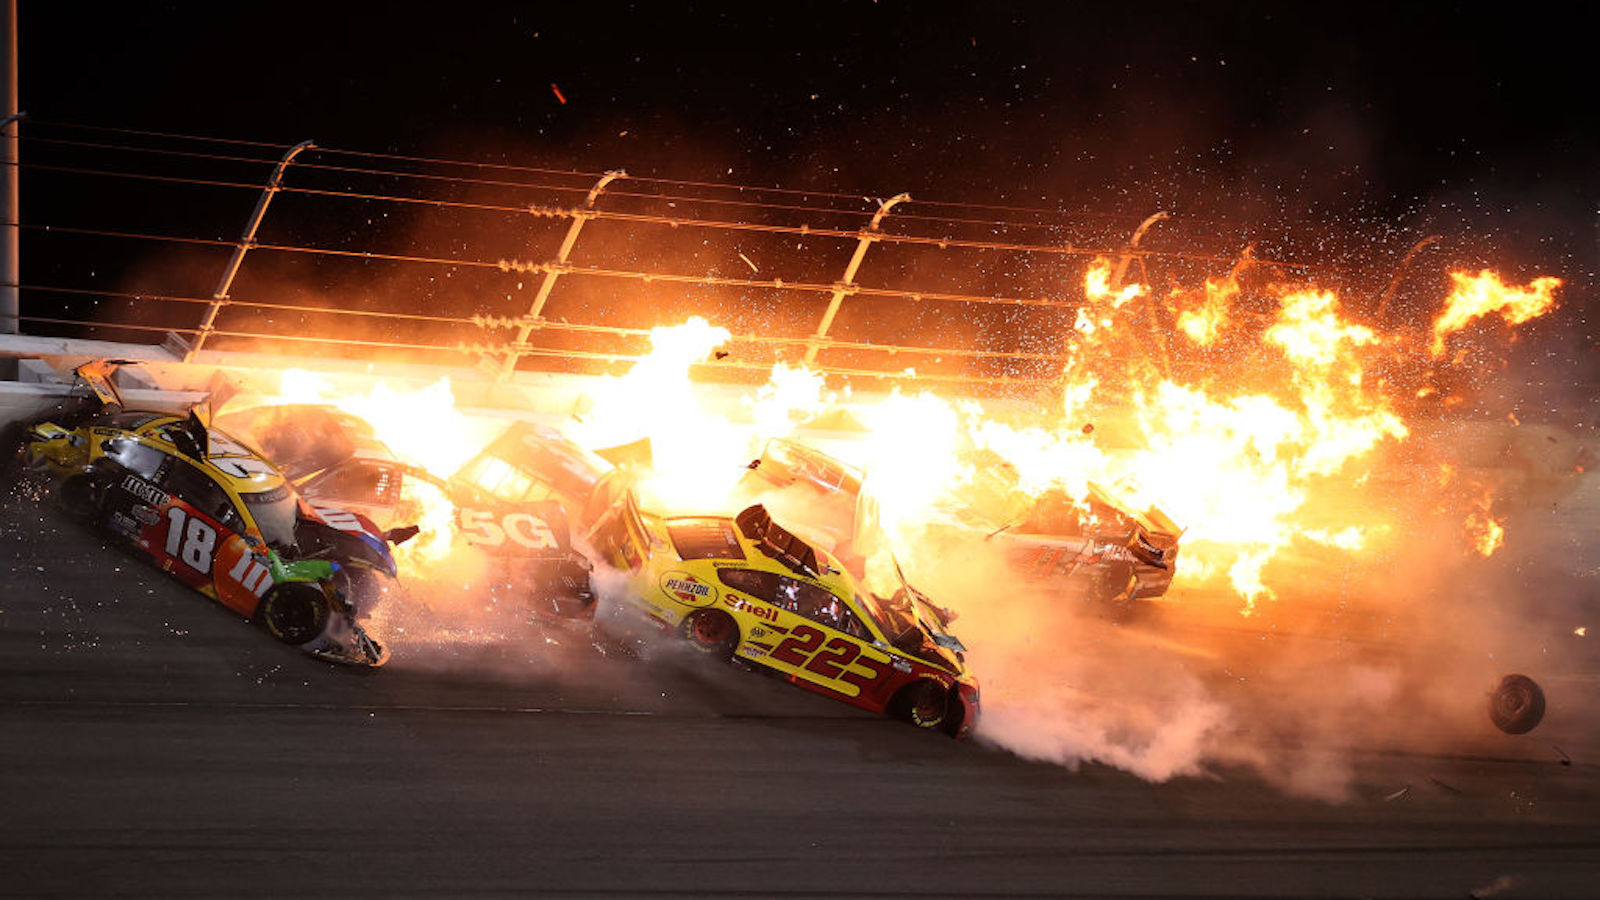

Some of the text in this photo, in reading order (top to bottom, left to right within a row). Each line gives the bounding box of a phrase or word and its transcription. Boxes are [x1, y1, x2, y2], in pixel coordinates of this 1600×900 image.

[165, 506, 217, 575] 18
[461, 507, 559, 549] 5G
[665, 578, 711, 597] PENNZOIL
[723, 592, 779, 622] Shell
[768, 624, 861, 681] 22
